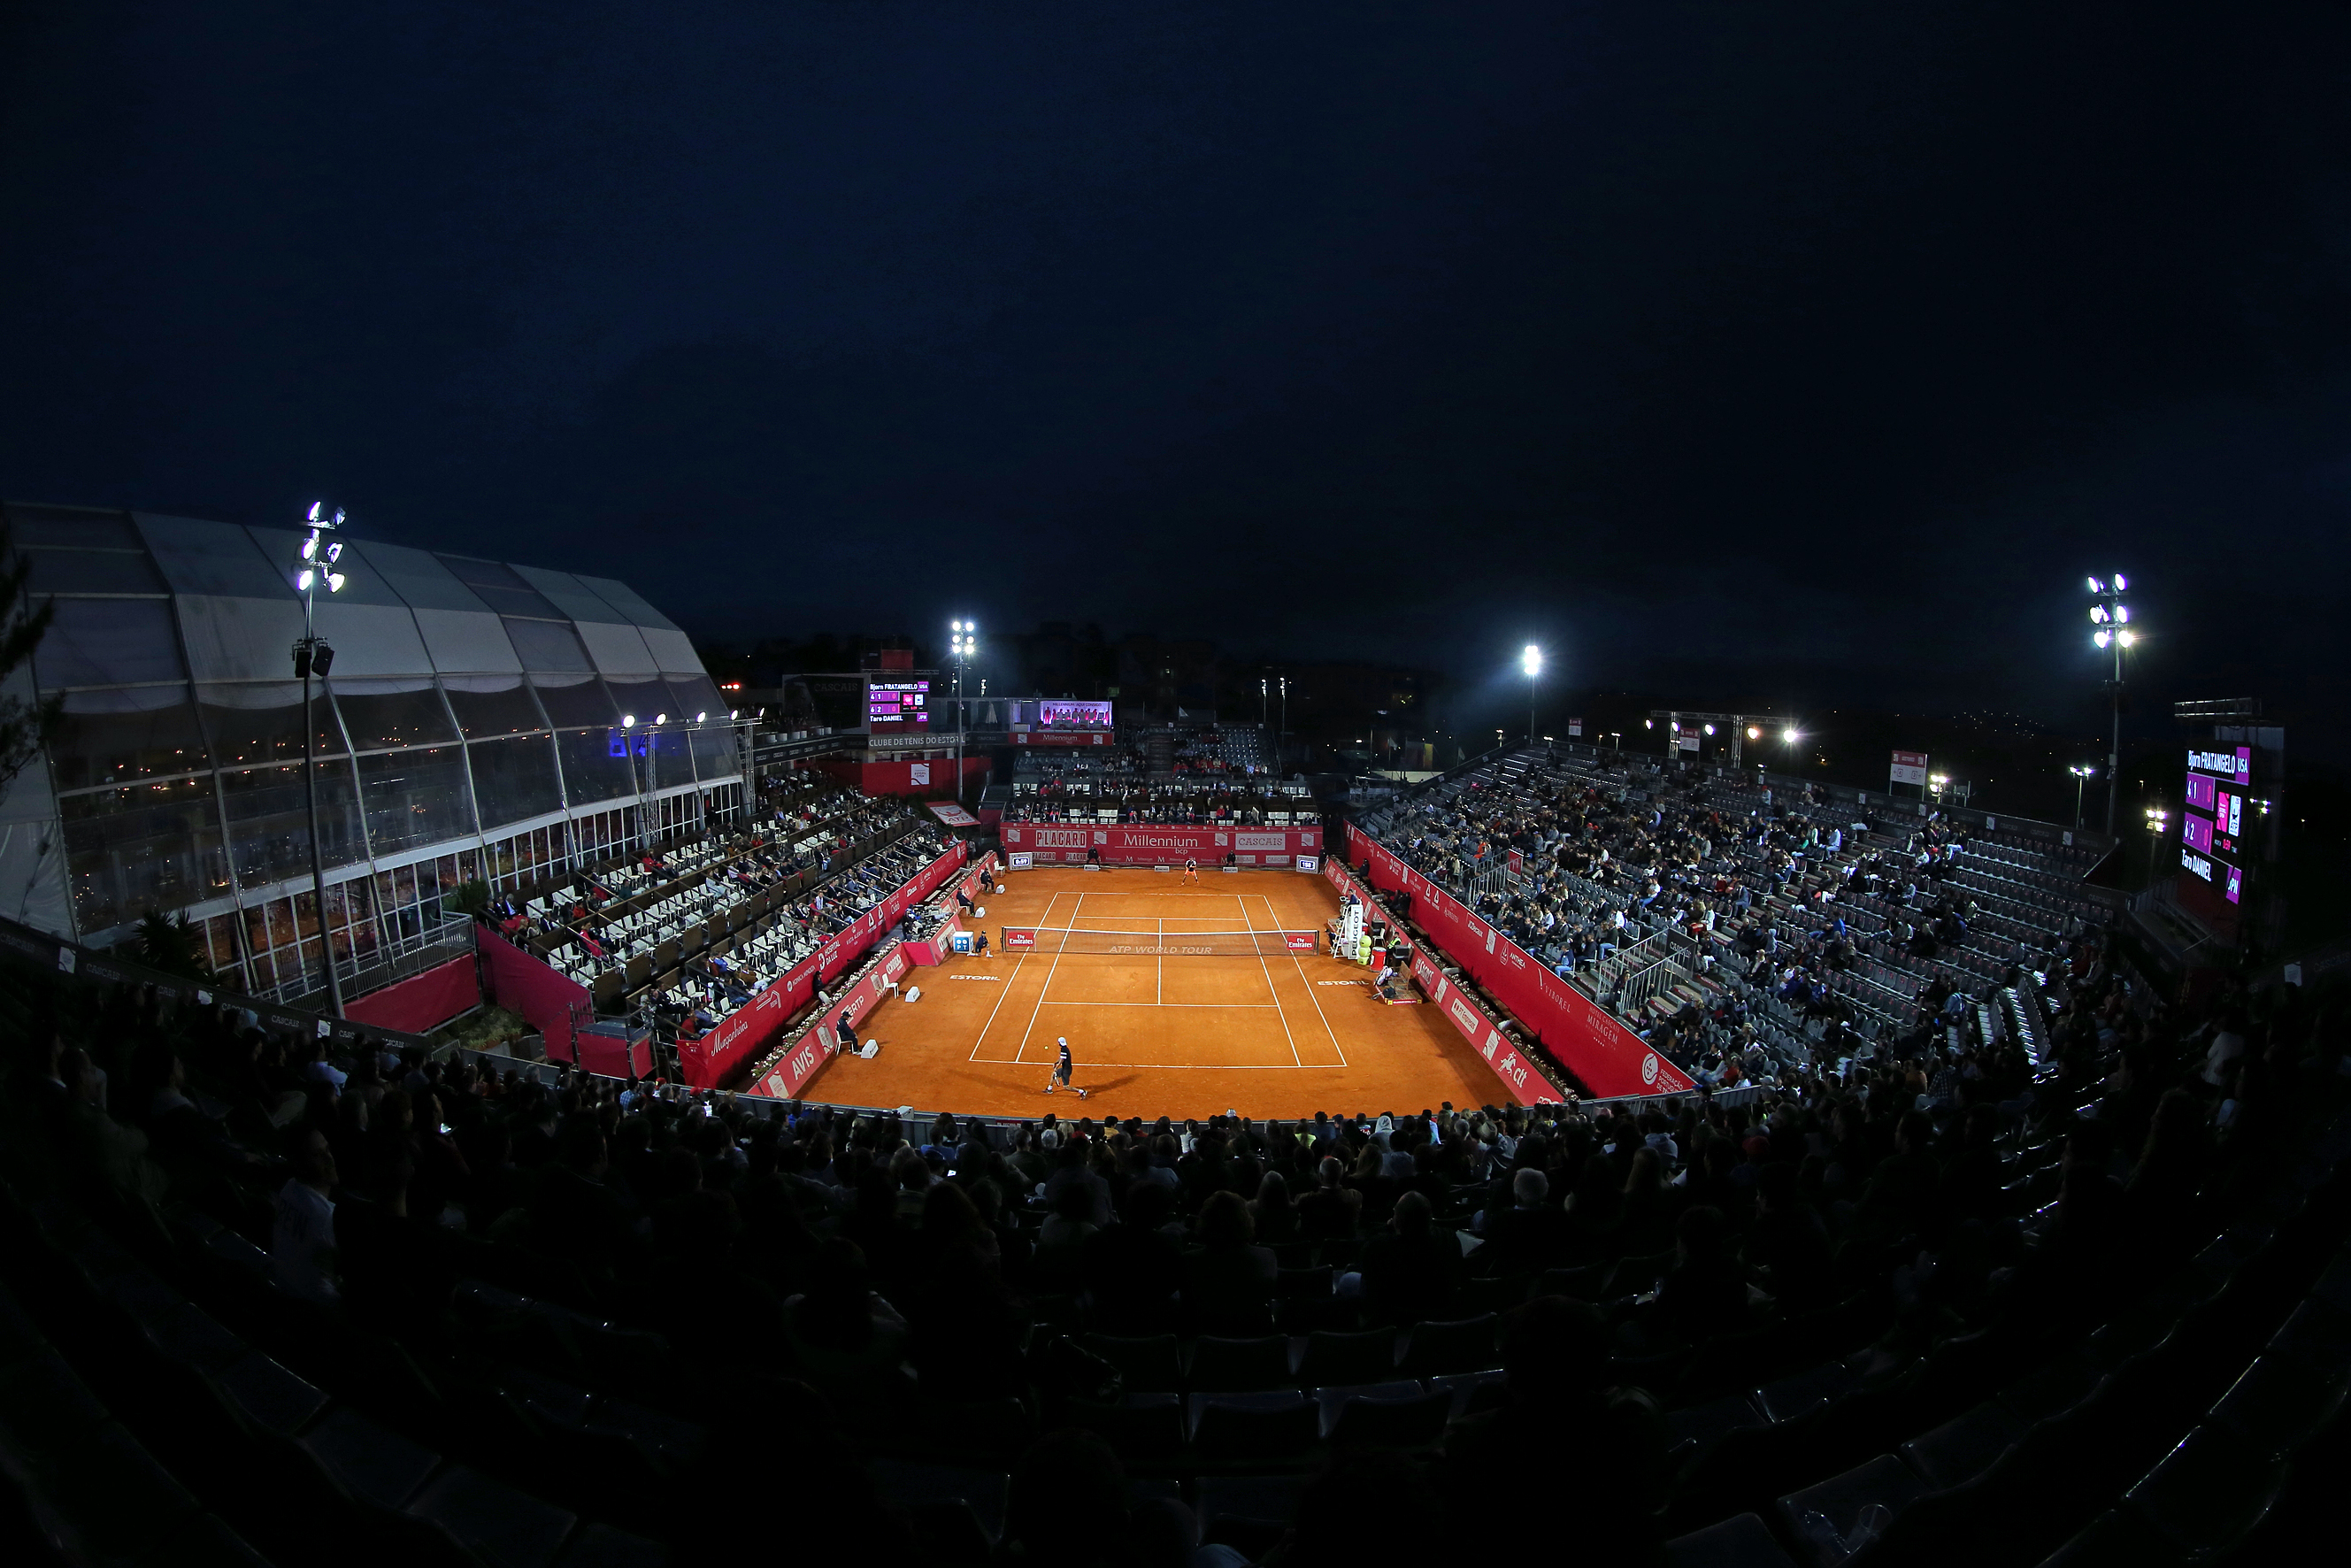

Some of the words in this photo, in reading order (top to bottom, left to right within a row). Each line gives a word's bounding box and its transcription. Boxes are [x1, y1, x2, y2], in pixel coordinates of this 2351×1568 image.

[869, 738, 892, 747] CLUBE
[904, 736, 924, 745] TÉNIS
[938, 735, 965, 744] ESTORL
[2188, 749, 2201, 772] Bjorn
[2201, 751, 2236, 774] FRATANGELO
[2237, 757, 2248, 773] USA
[1036, 831, 1087, 847] PLACARD
[1124, 832, 1198, 847] Millennium
[1239, 837, 1283, 846] CASCAIS
[2182, 849, 2193, 871] Taro
[2192, 855, 2211, 882] DANIEL
[824, 940, 841, 957] HOSPITAL
[1109, 945, 1132, 954] ATP
[1510, 952, 1525, 969] ANTHEA
[850, 995, 864, 1015] RTP
[1545, 985, 1571, 1013] VIBOREL
[271, 1014, 300, 1028] CASCAIS
[1589, 1006, 1602, 1020] HOTEL
[711, 1018, 749, 1057] Murganheira
[1587, 1014, 1618, 1045] MIRAGEM
[791, 1045, 814, 1080] AVIS
[1513, 1067, 1527, 1088] ctt
[1660, 1068, 1684, 1091] FEDERAÇÃO
[1656, 1082, 1663, 1092] DE
